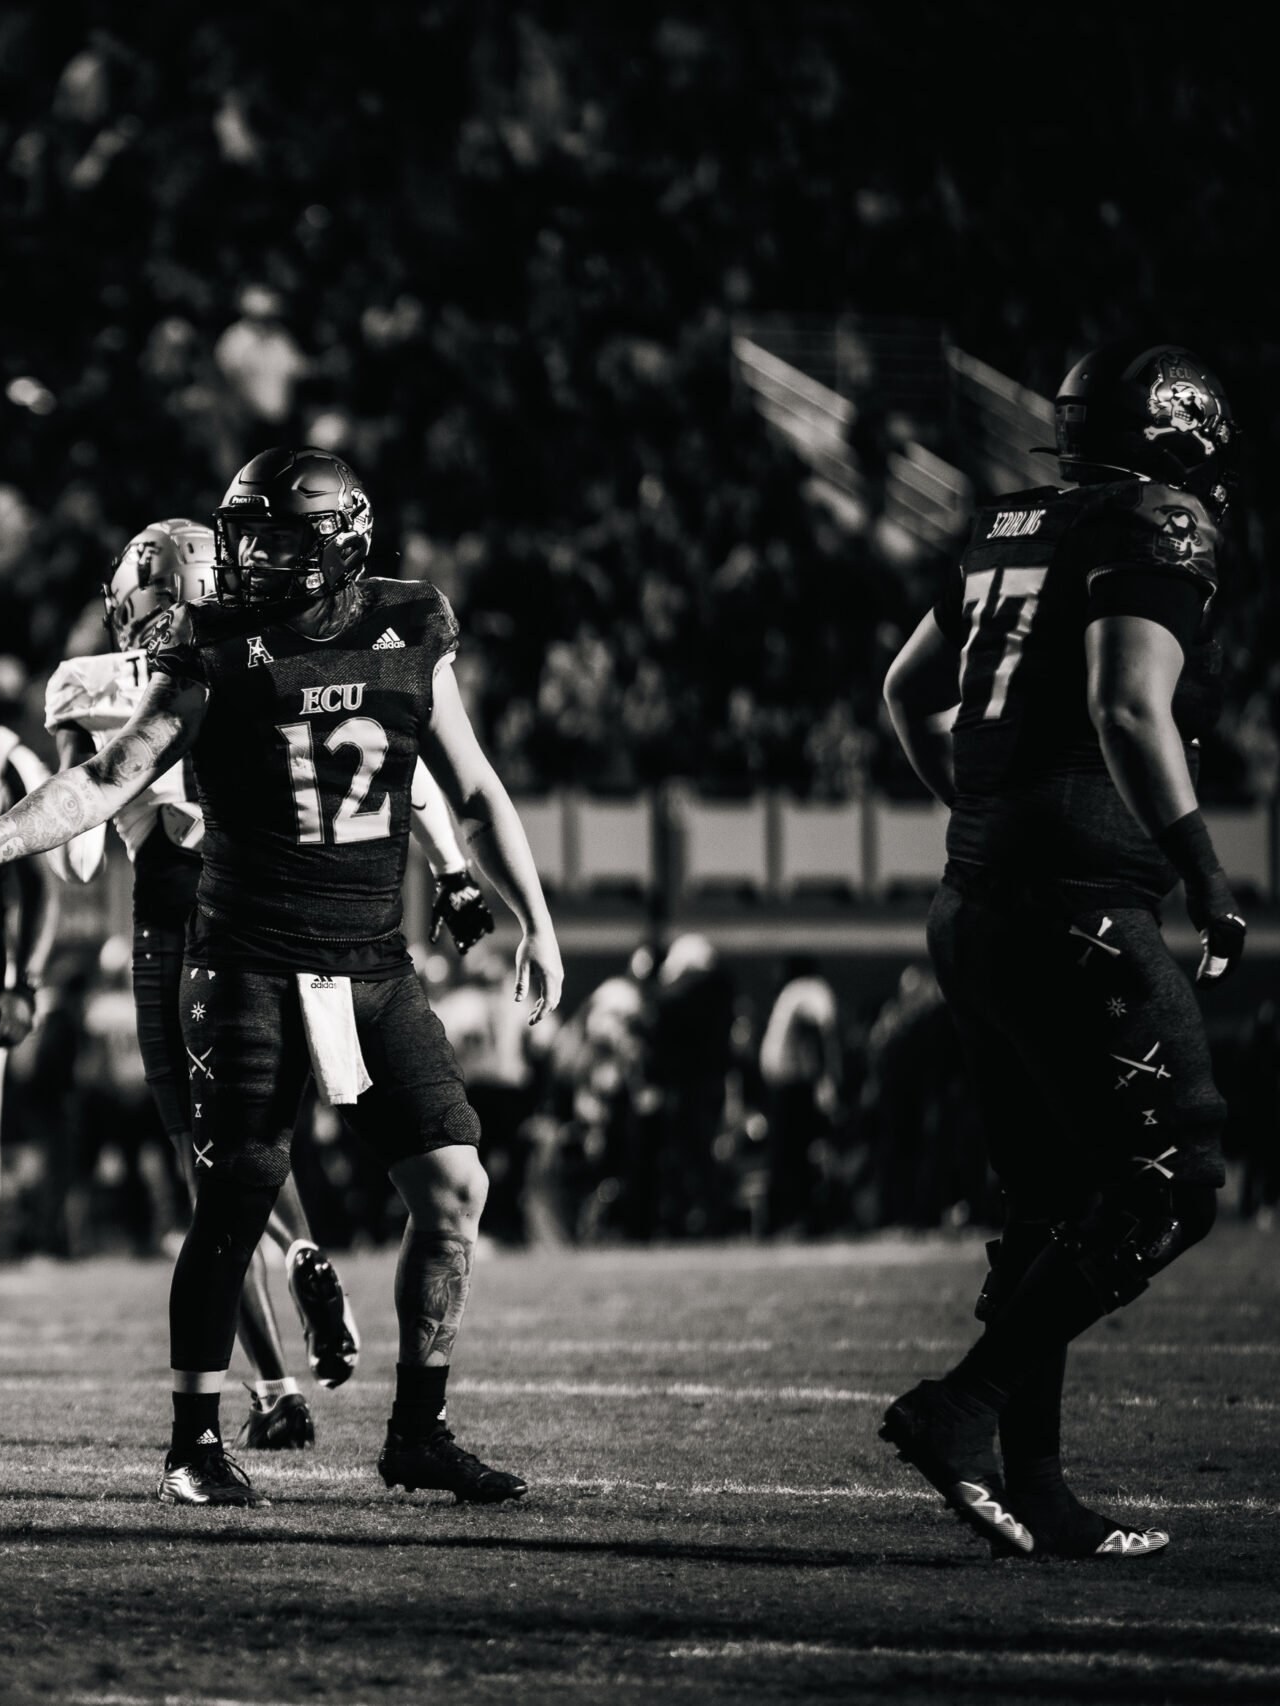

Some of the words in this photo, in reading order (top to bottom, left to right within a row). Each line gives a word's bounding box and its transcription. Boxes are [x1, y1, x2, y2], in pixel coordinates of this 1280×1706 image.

[1169, 367, 1191, 379] ECU
[372, 639, 406, 650] adidas
[959, 566, 1049, 720] 77
[298, 682, 368, 715] ECU
[273, 716, 392, 844] 12
